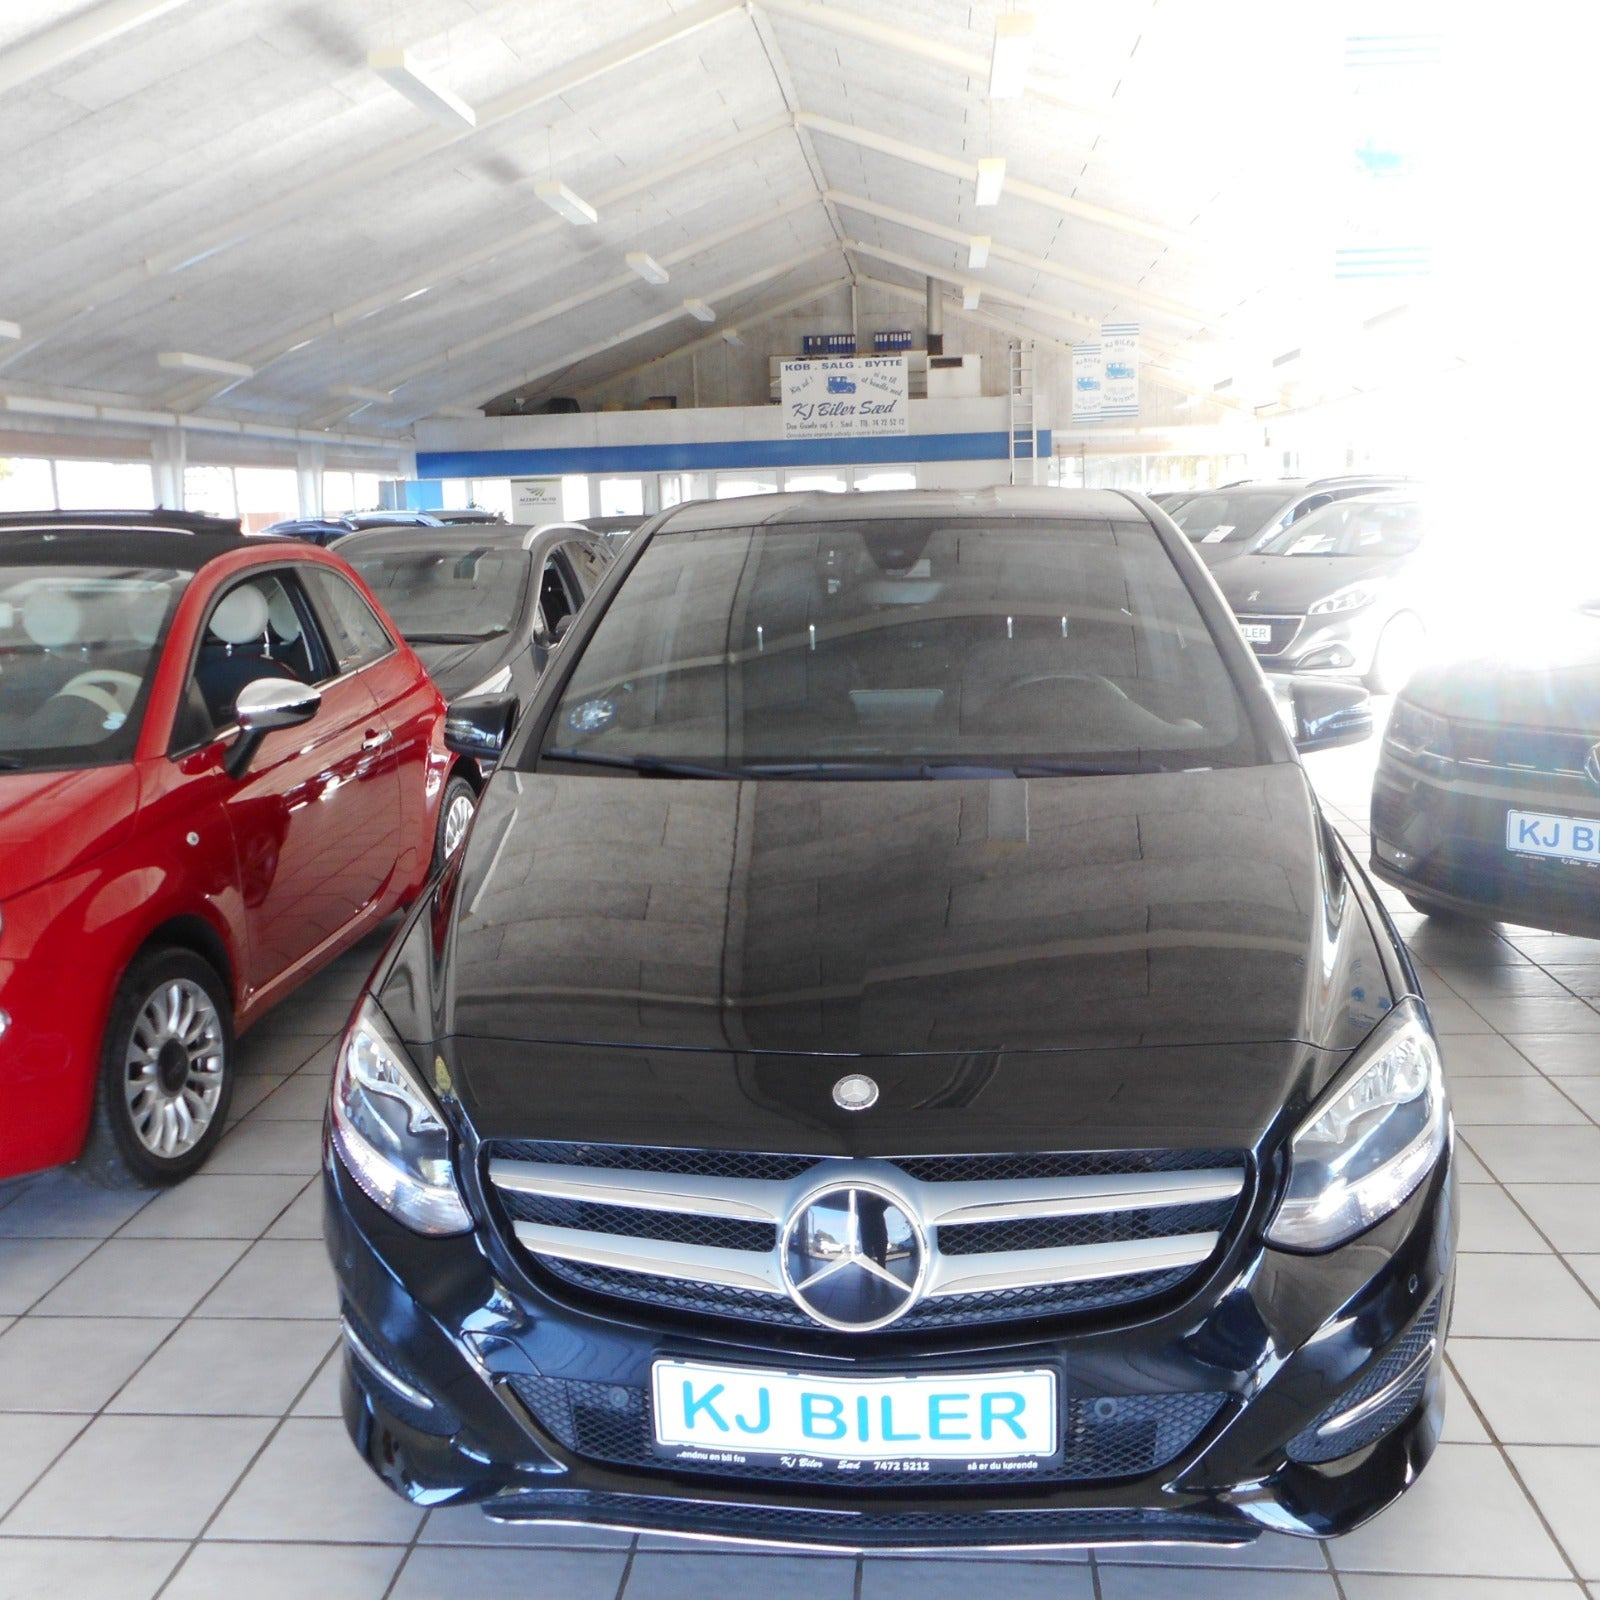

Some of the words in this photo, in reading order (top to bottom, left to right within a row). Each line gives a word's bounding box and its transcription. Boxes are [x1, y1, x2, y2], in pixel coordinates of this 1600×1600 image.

[785, 363, 811, 371] KØB
[821, 361, 854, 370] SALG
[865, 359, 903, 368] BYTTE
[792, 402, 815, 421] KJ
[818, 401, 856, 417] Biler
[859, 399, 898, 415] Sæd
[1241, 627, 1267, 637] LER
[1519, 819, 1560, 848] KJ
[682, 1380, 771, 1434] KJ
[800, 1390, 1028, 1442] BILER
[798, 1458, 824, 1468] Biler
[873, 1461, 900, 1471] 7472
[902, 1461, 930, 1471] 5212
[979, 1462, 989, 1470] er
[990, 1461, 1002, 1470] du
